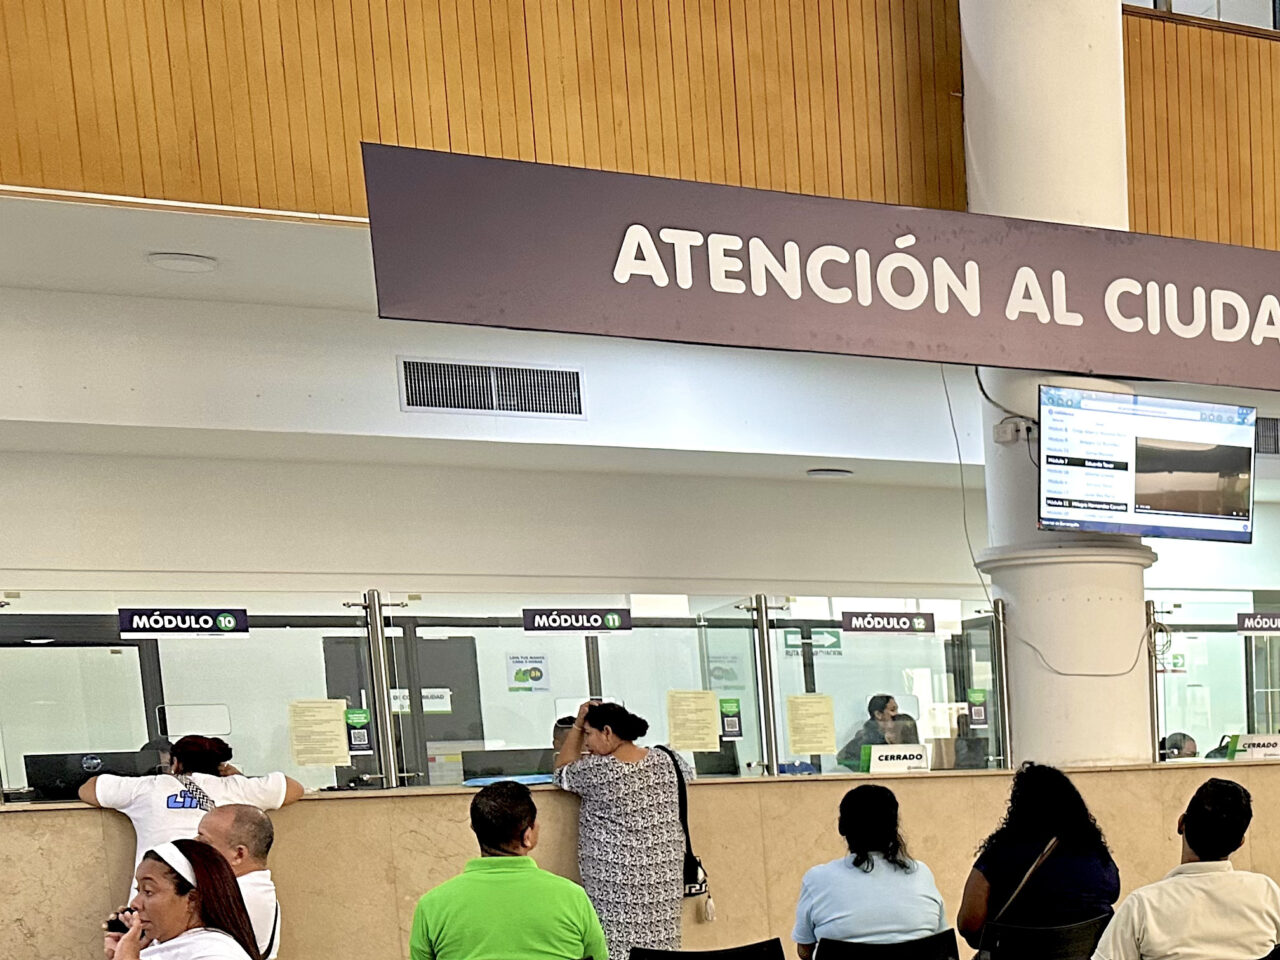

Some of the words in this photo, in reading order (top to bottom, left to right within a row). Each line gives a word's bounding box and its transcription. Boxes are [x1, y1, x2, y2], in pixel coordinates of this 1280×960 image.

[613, 223, 981, 316] ATENCIÓN
[1005, 266, 1084, 326] AL
[132, 611, 213, 629] MÓDULO
[534, 611, 602, 628] MÓDULO
[851, 613, 910, 630] MÓDULO
[1242, 741, 1278, 749] CERRADO
[878, 753, 923, 761] CERRADO
